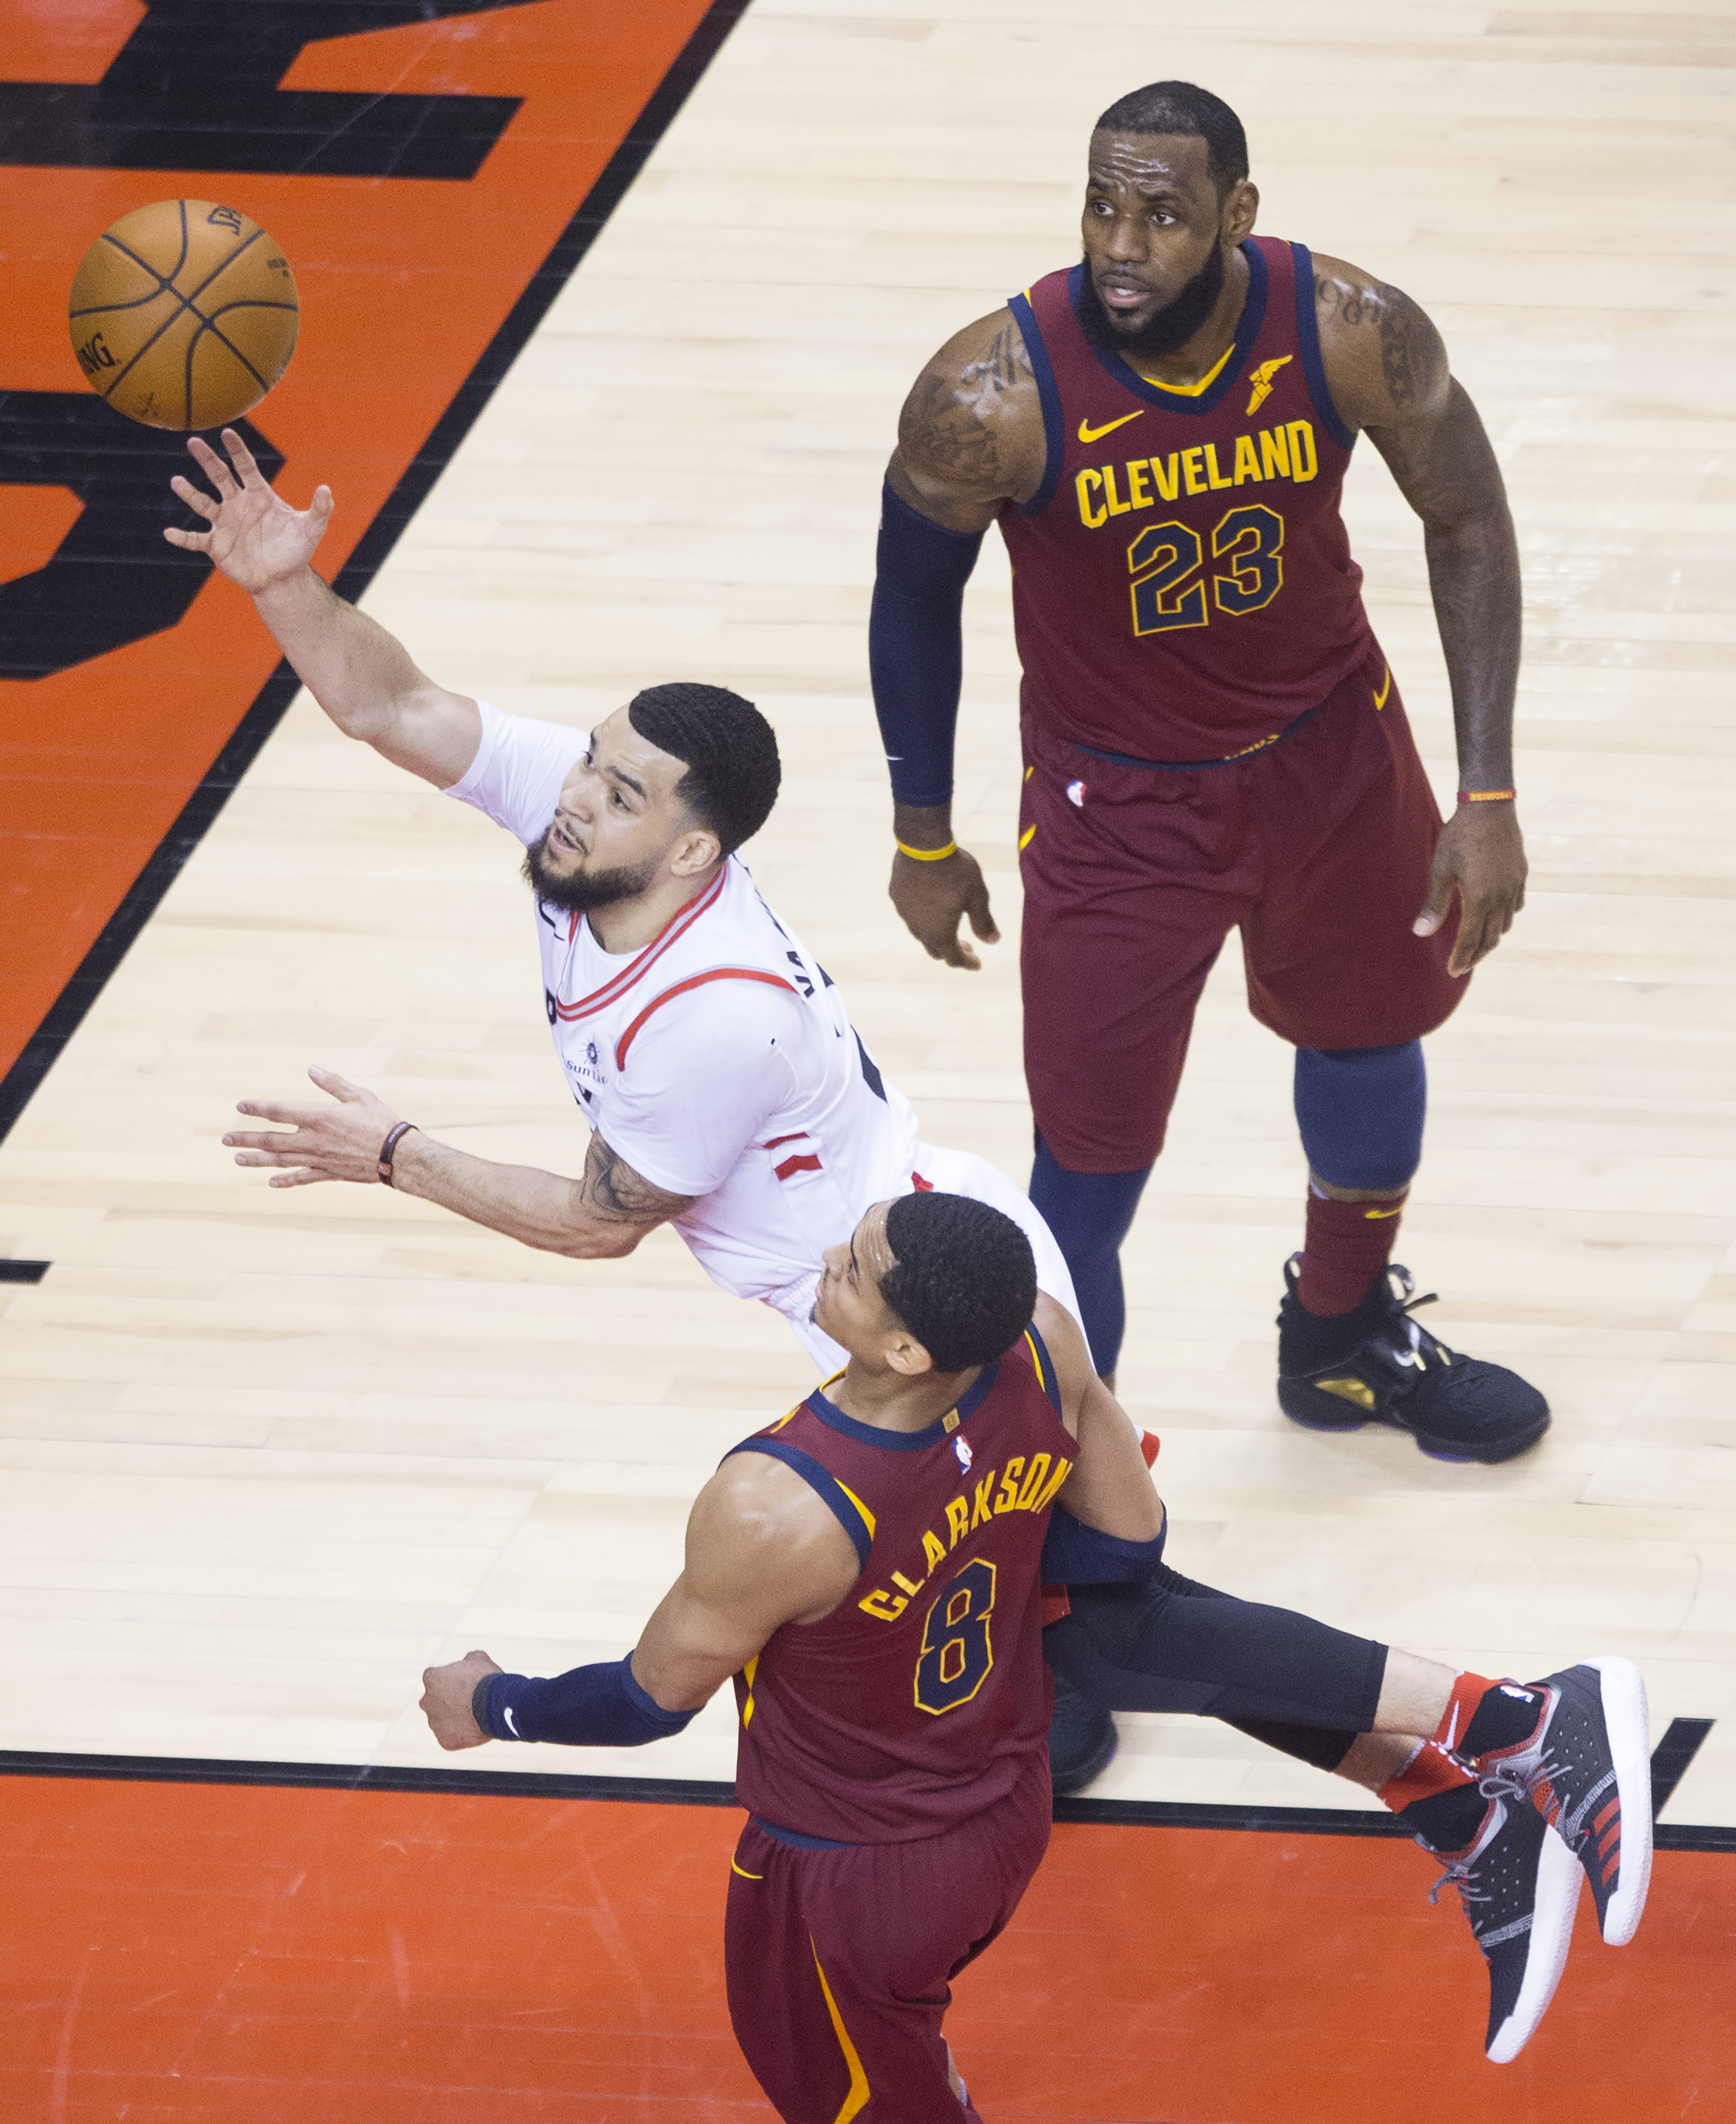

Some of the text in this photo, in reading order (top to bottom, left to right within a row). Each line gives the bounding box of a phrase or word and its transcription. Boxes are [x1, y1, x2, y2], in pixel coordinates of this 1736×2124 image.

[1075, 419, 1318, 529] CLEVELAND
[1127, 503, 1284, 637] 23
[567, 1060, 590, 1076] Sun
[858, 1453, 1073, 1622] CLARKSON
[914, 1557, 997, 1716] 8
